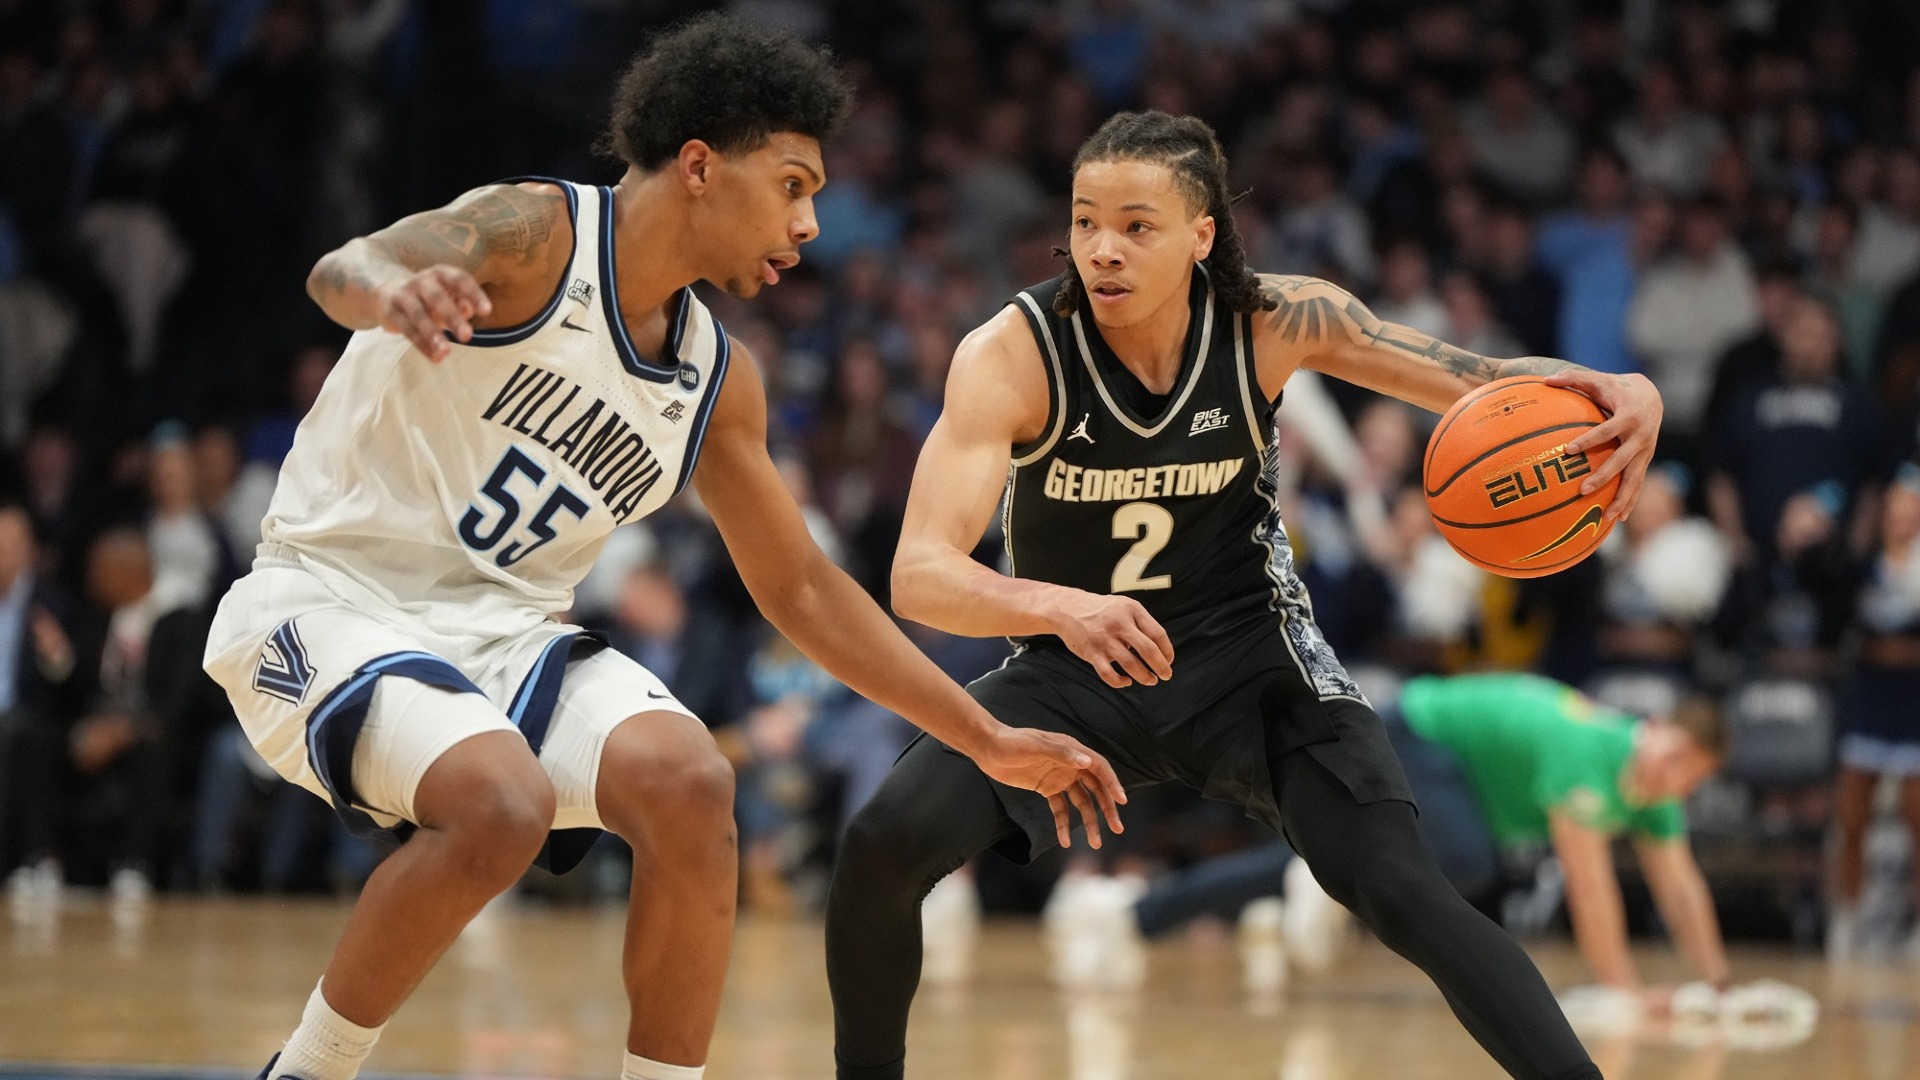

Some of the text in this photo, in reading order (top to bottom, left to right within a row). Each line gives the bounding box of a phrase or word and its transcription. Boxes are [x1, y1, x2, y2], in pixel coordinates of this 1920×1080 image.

[681, 369, 697, 385] GHR
[663, 406, 683, 422] EAST
[670, 400, 685, 413] BIG
[1190, 414, 1230, 432] EAST
[1193, 407, 1222, 422] BIG
[481, 363, 663, 526] VILLANOVA
[1044, 457, 1245, 502] GEORGETOWN
[1485, 451, 1592, 510] ELITE
[458, 444, 591, 568] 55
[1111, 502, 1174, 594] 2
[252, 618, 318, 708] V
